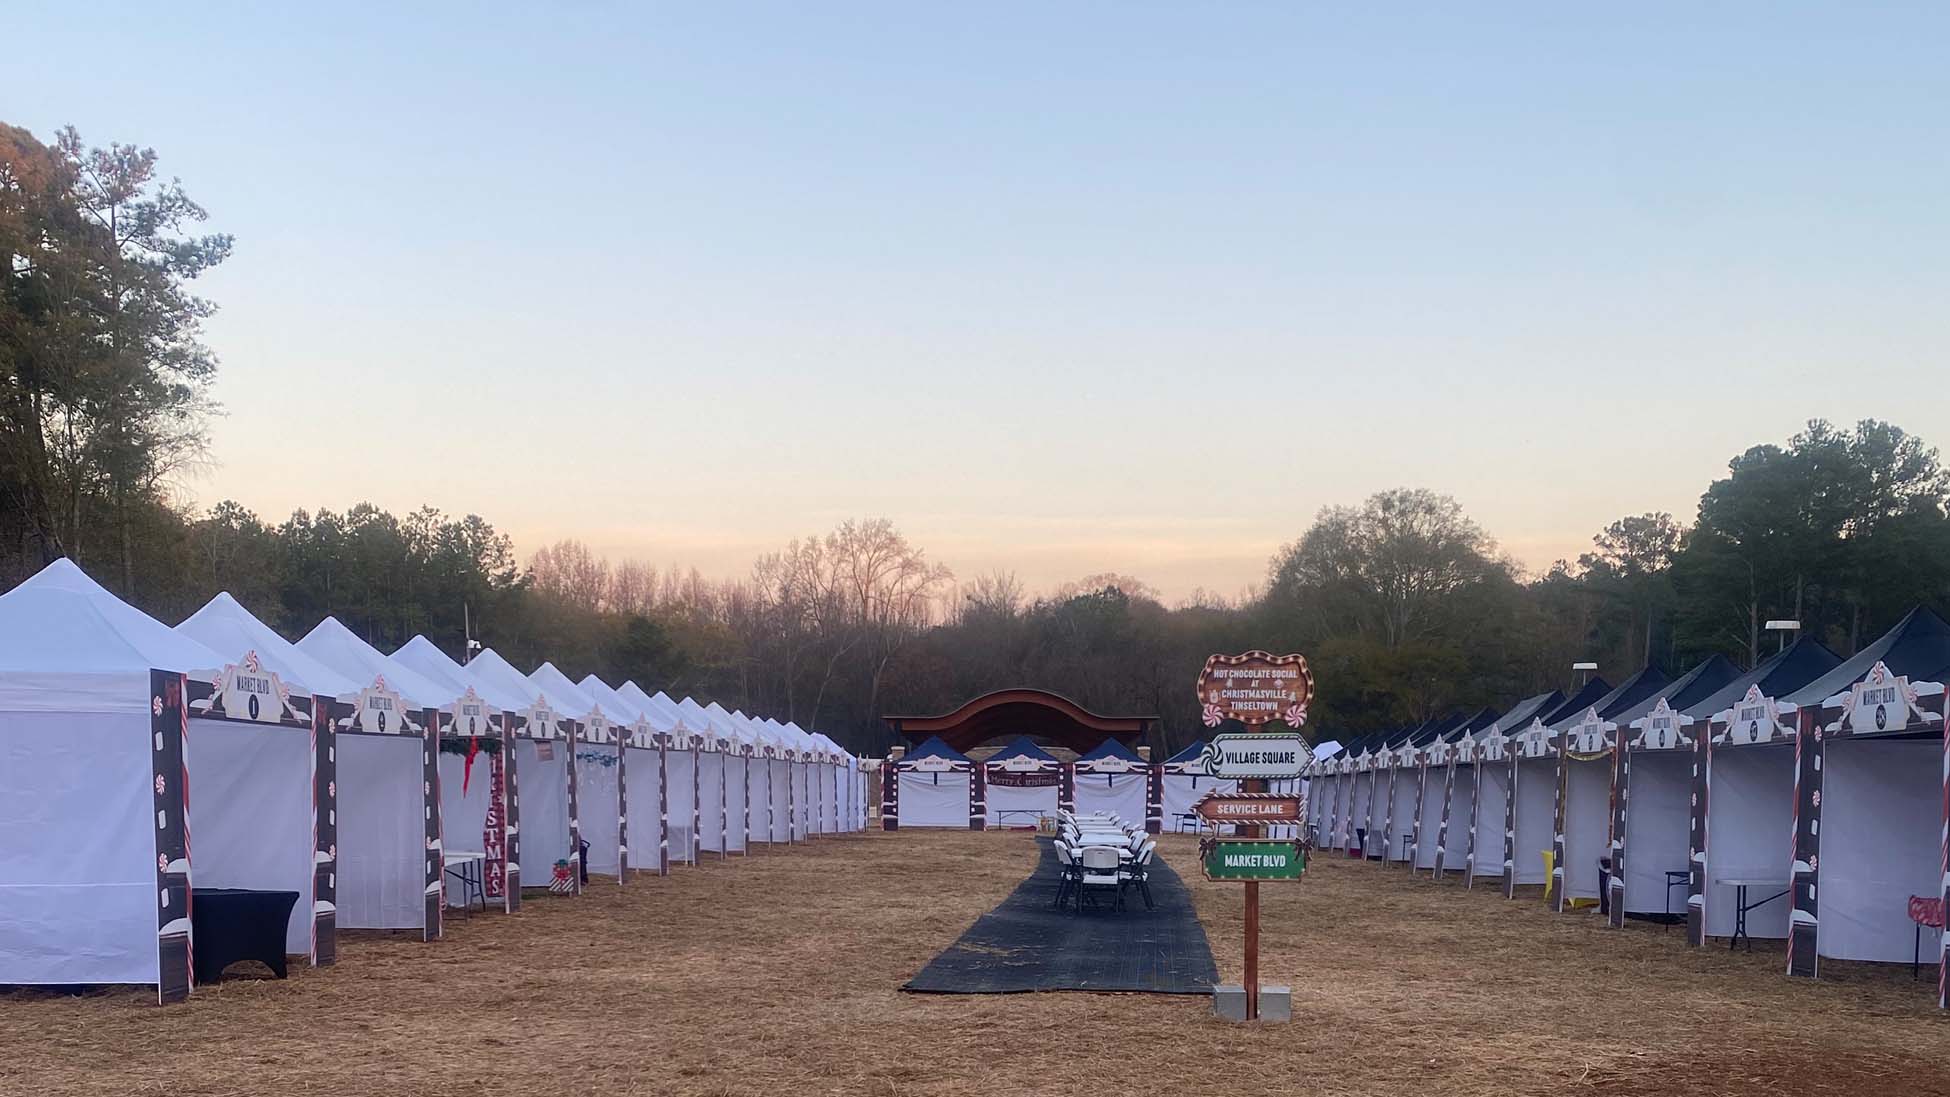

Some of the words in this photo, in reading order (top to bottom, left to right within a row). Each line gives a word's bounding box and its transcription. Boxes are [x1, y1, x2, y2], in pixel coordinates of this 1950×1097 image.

[1213, 669, 1228, 678] HOT
[1229, 669, 1270, 679] CHOCOLATE
[1271, 669, 1297, 678] SOCIAL
[236, 675, 256, 693] MARKET
[257, 678, 270, 695] BLVD
[1221, 689, 1287, 699] CHRISTMASVILLE
[1231, 701, 1279, 711] TINSELTOWN
[1225, 751, 1261, 764] VILLAGE
[1262, 751, 1295, 764] SQUARE
[1217, 804, 1257, 814] SERVICE
[1258, 804, 1283, 814] LANE
[1224, 854, 1262, 867] MARKET
[1263, 854, 1286, 867] BLVD
